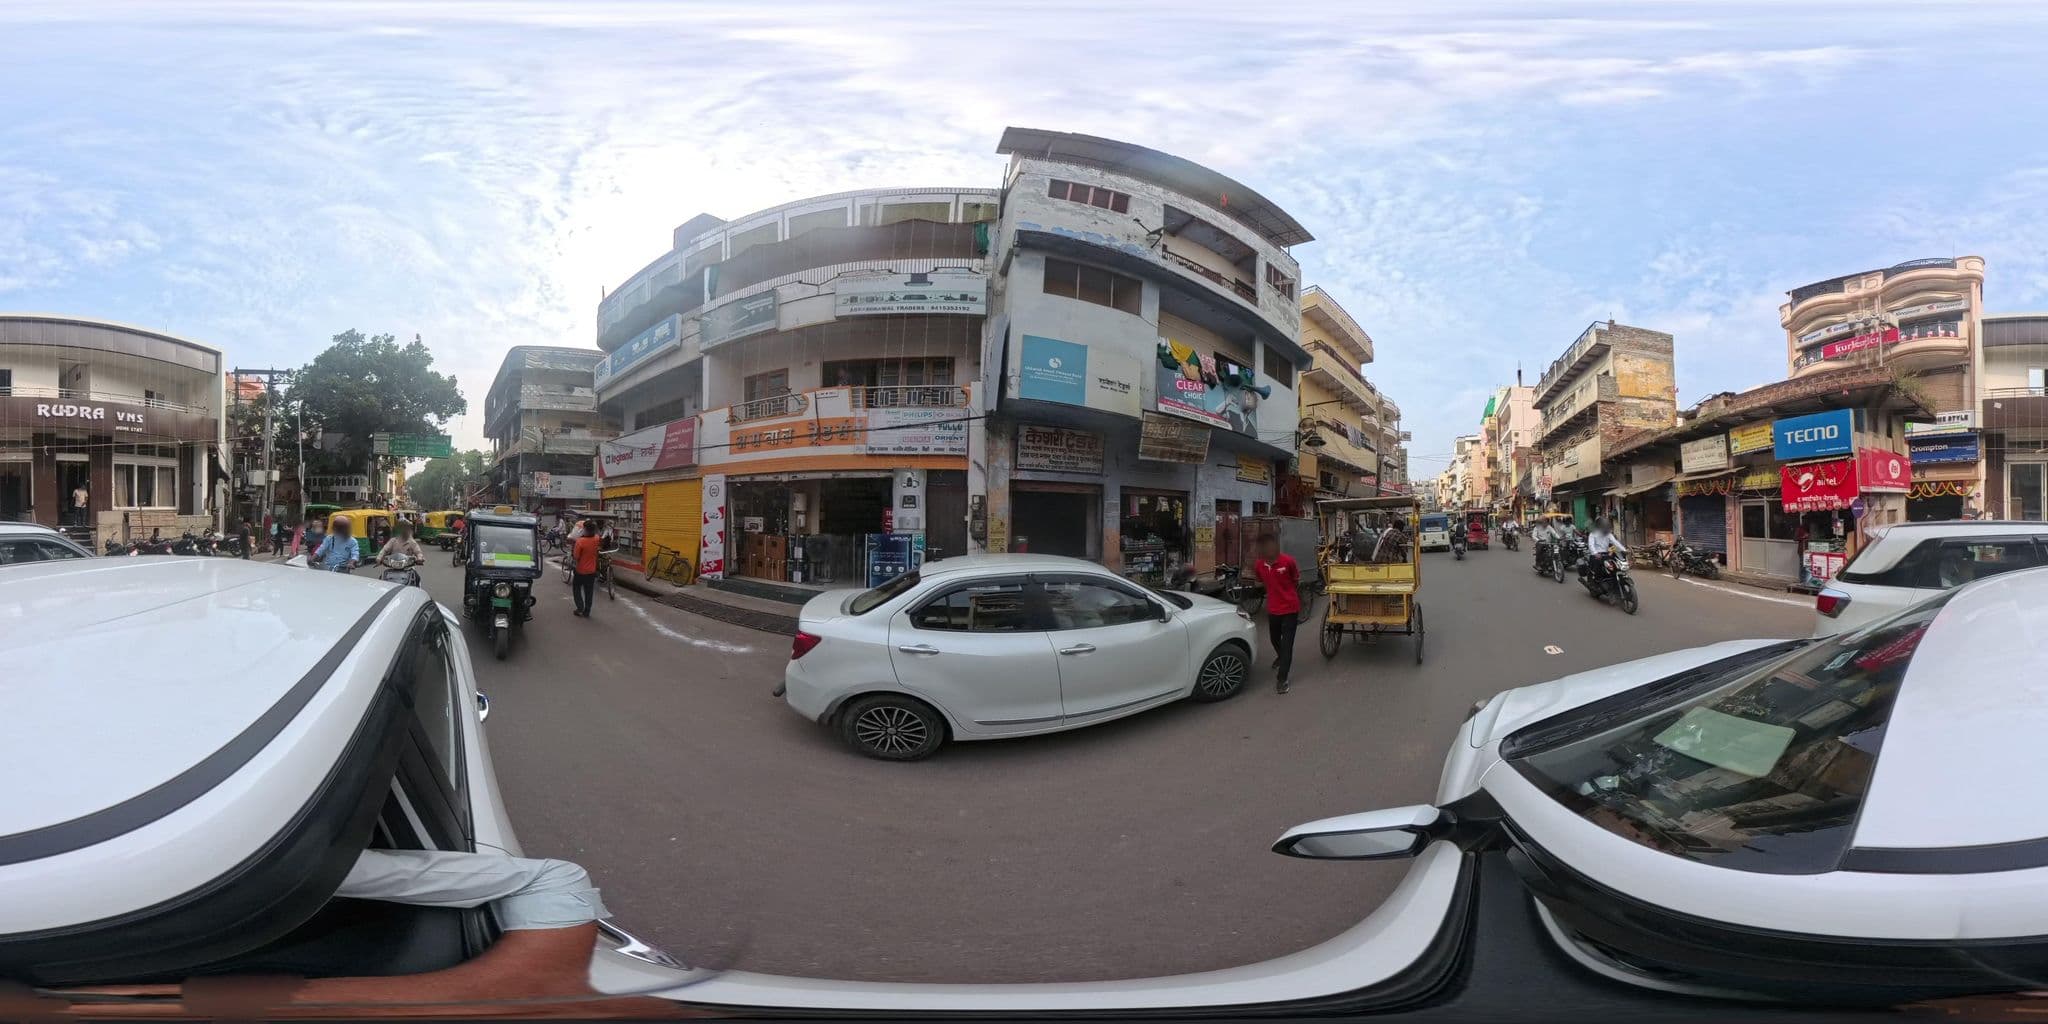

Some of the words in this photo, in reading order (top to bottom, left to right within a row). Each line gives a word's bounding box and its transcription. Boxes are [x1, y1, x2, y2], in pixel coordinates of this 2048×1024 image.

[1176, 380, 1204, 392] CLEAR
[1183, 391, 1206, 401] CHOICE
[37, 404, 105, 420] RUDRA
[116, 411, 144, 423] VNS
[1948, 414, 1968, 422] STYLE
[1784, 425, 1839, 444] TECNO
[1911, 443, 1949, 453] Crompton
[611, 449, 634, 465] legrand
[1817, 477, 1837, 486] airtel
